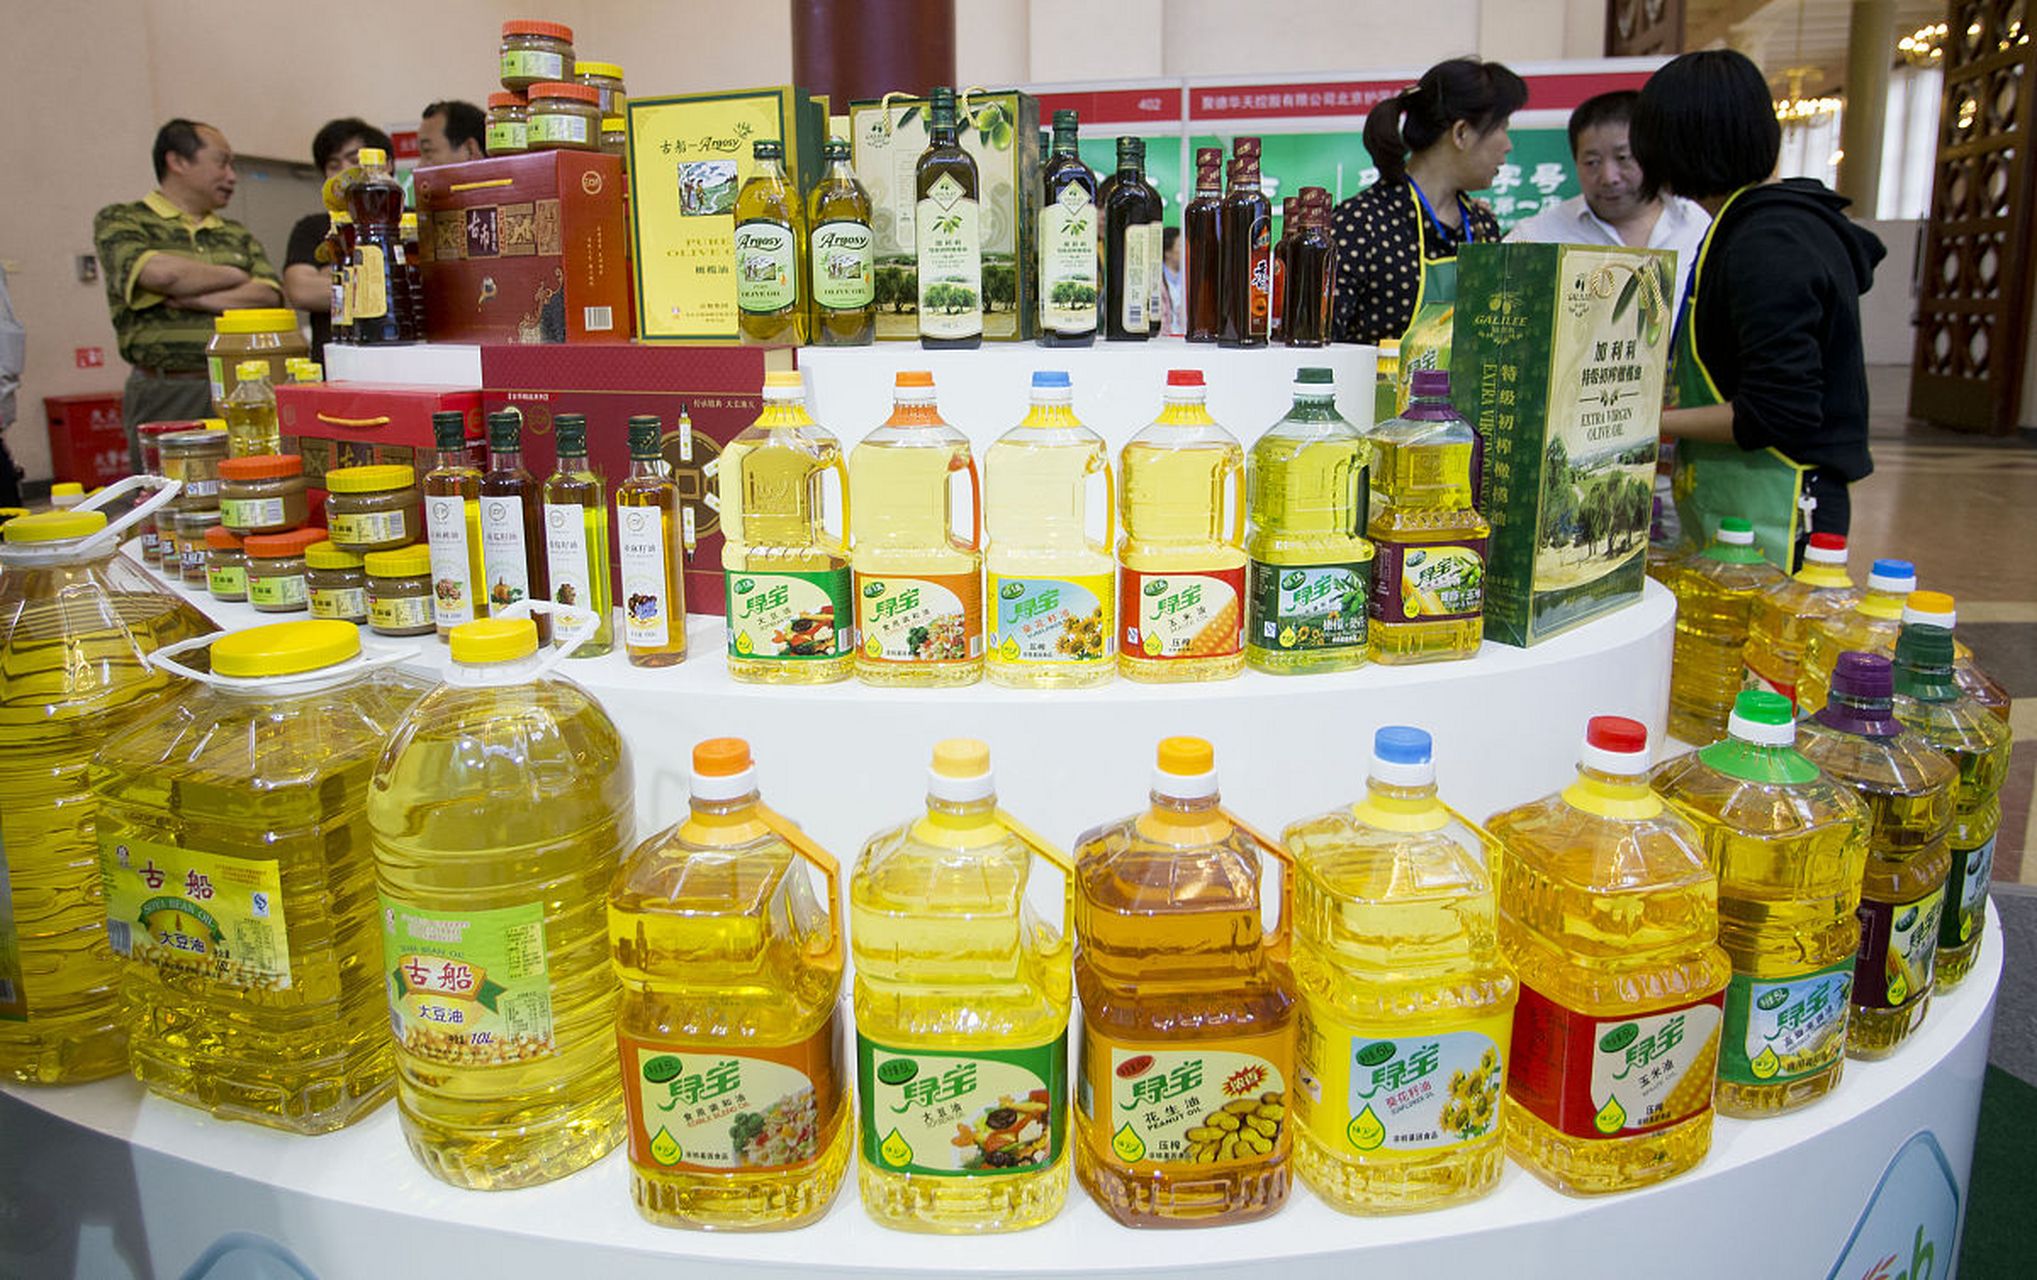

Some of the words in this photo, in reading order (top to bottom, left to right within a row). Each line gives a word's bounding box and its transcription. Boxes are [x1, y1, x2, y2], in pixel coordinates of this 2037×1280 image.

[1137, 97, 1162, 111] 402
[698, 136, 743, 153] Argosy
[737, 233, 784, 251] Argosy
[819, 232, 870, 251] Argosy
[1474, 315, 1529, 327] GALILEE
[1594, 339, 1637, 362] 加利利
[1481, 364, 1498, 405] EXTRA
[1581, 366, 1642, 387] 特级初榨橄榄油
[1581, 412, 1606, 428] EXTRA
[1606, 407, 1634, 423] VIRGIN
[1491, 364, 1518, 528] 特级初榨橄榄油
[1587, 429, 1611, 442] OLIVE
[1612, 426, 1625, 438] OIL
[1413, 556, 1452, 588] 绿宝
[739, 585, 788, 619] 绿宝
[868, 588, 919, 622] 绿宝
[1006, 588, 1060, 624] 绿宝
[1150, 584, 1202, 620] 绿宝
[1285, 574, 1332, 612] 绿宝
[139, 860, 214, 900] 古船
[159, 930, 206, 954] 大豆油
[404, 957, 473, 992] 古船
[418, 1004, 464, 1024] 大豆油
[1762, 980, 1831, 1042] 绿宝
[471, 1031, 495, 1045] 10L
[1612, 1015, 1685, 1080] 绿宝
[1119, 1058, 1203, 1111] 绿宝
[1357, 1042, 1440, 1099] 绿宝
[1639, 1058, 1675, 1089] 玉米油
[657, 1059, 741, 1112] 绿宝
[890, 1063, 978, 1113] 绿宝
[1386, 1080, 1433, 1108] 葵花籽油
[683, 1093, 747, 1122] 食用调和油
[922, 1102, 964, 1123] 大豆油
[1143, 1097, 1201, 1125] 花生油
[1146, 1112, 1185, 1132] PEANUT
[1186, 1106, 1203, 1118] OIL
[1158, 1140, 1181, 1151] 压榨
